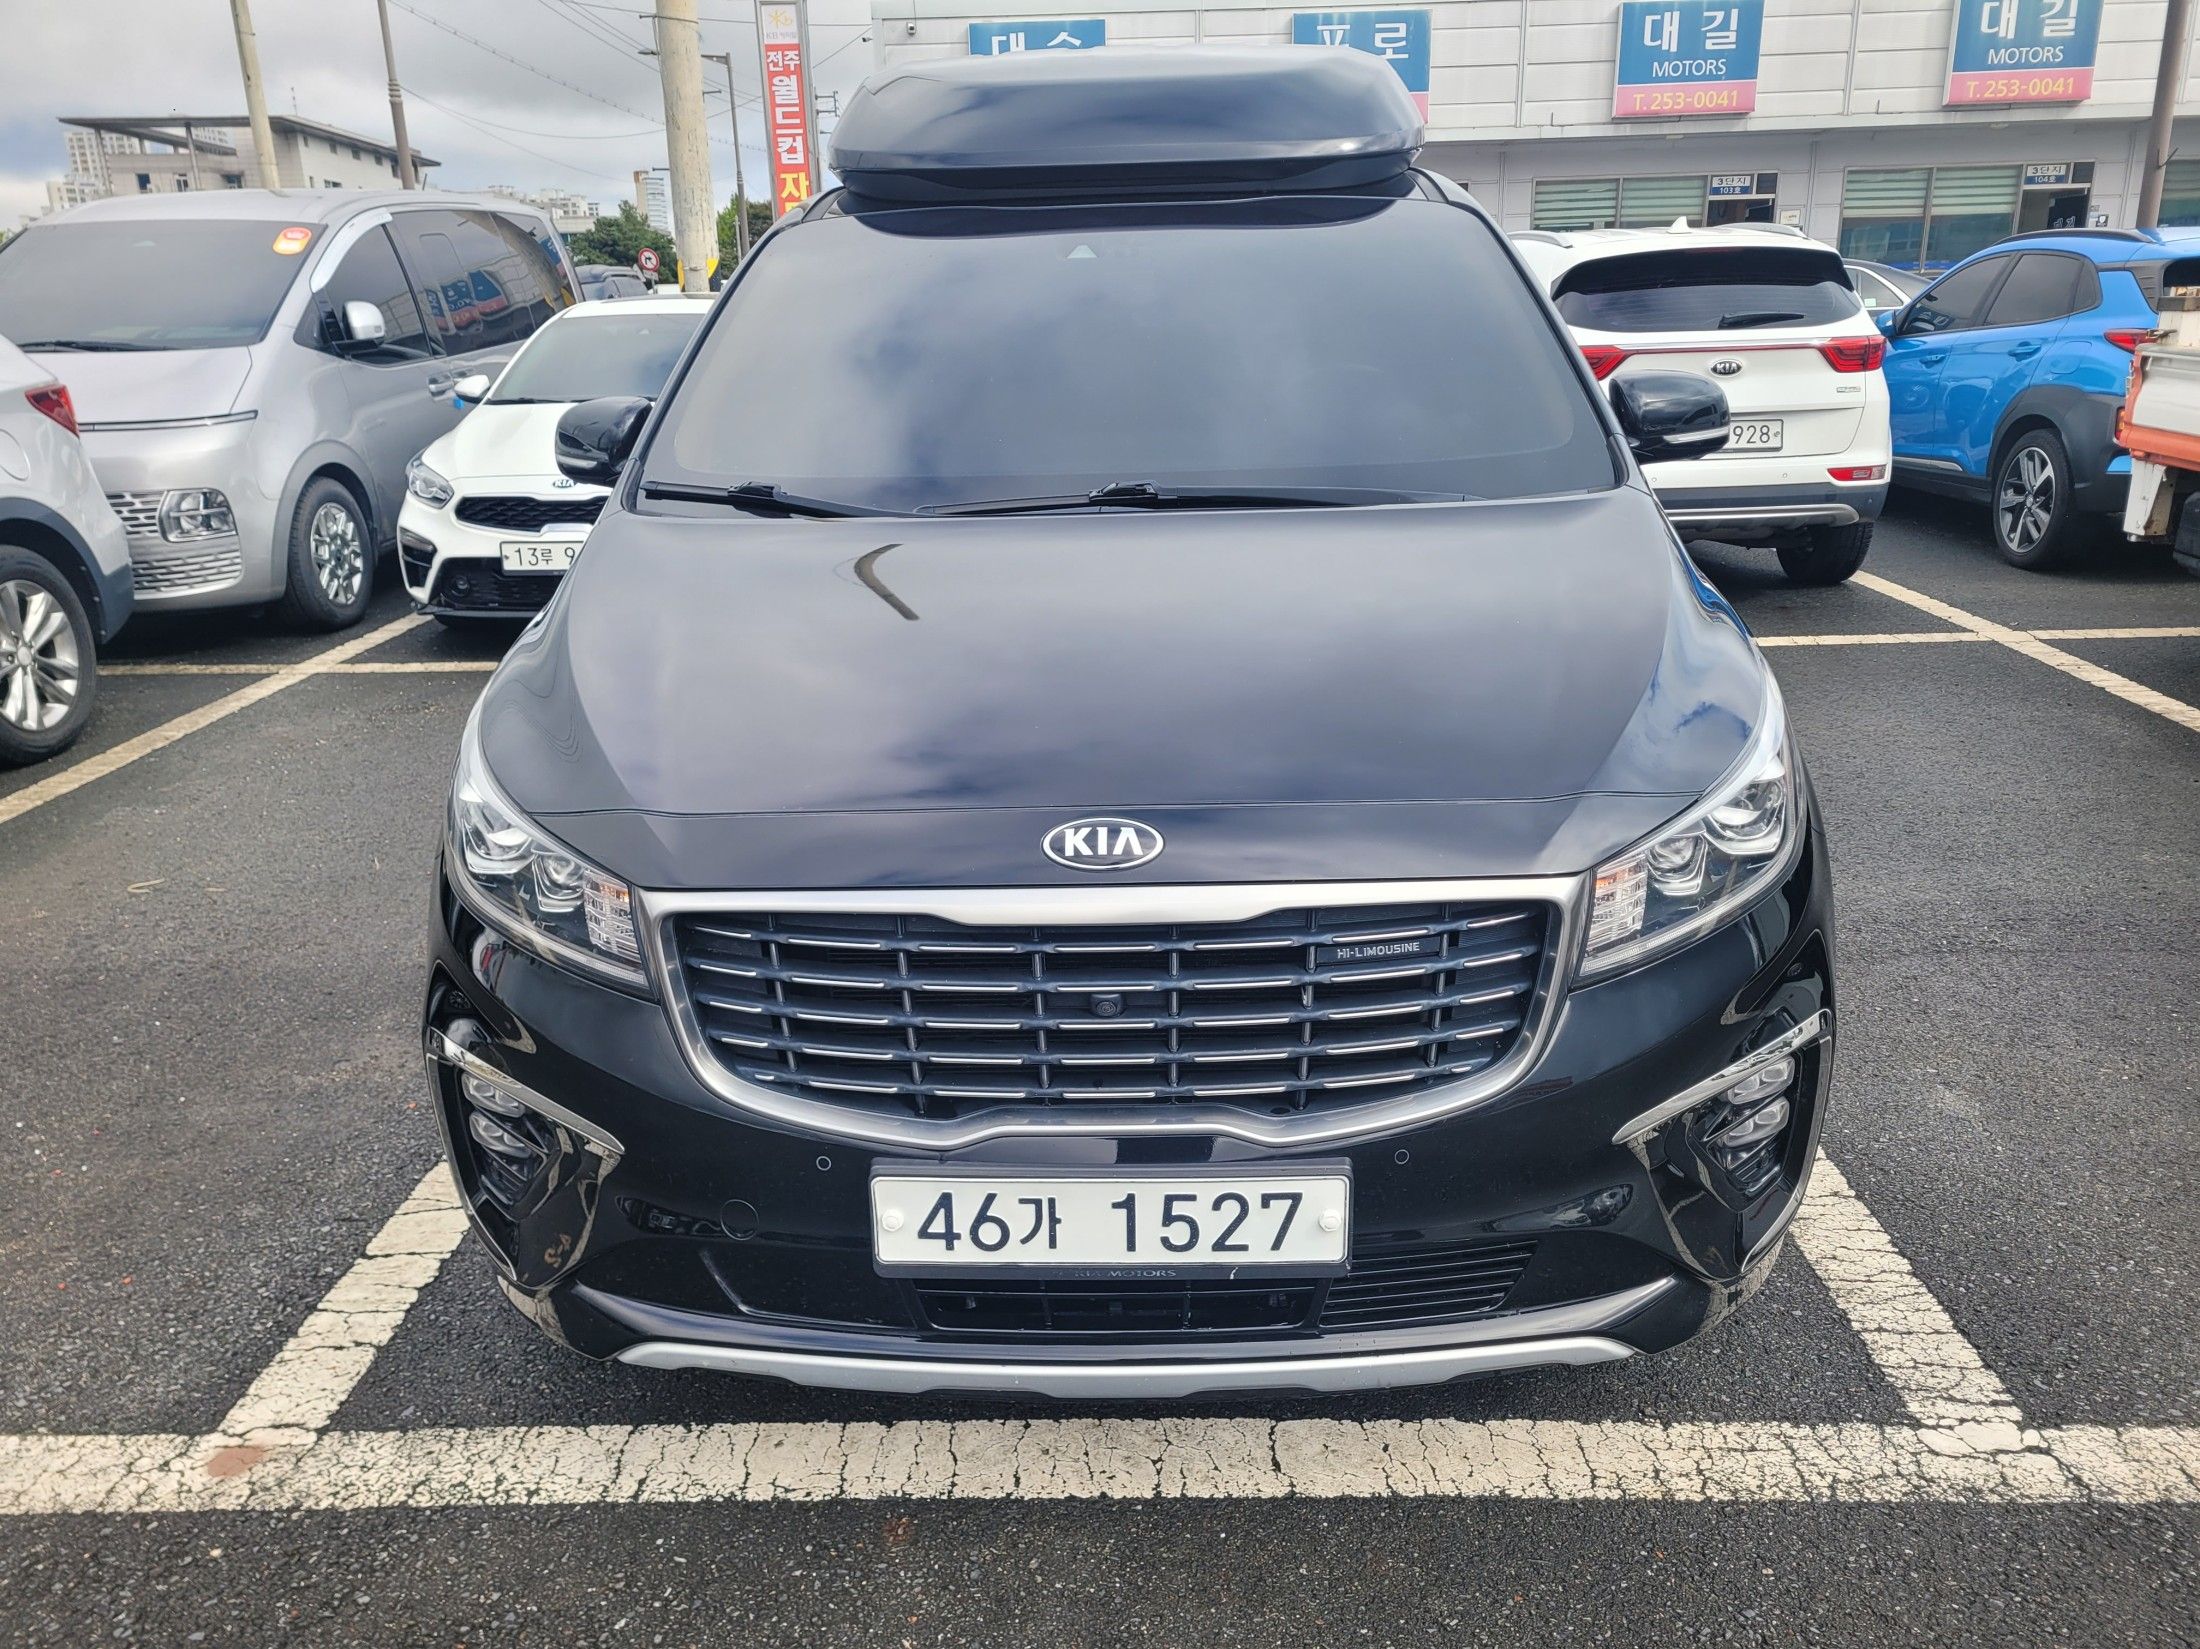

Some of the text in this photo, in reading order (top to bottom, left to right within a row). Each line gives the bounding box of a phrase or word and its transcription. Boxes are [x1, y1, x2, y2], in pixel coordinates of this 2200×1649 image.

[766, 50, 801, 72] 전주
[1987, 46, 2064, 65] MOTORS
[1652, 58, 1727, 78] MOTORS
[1967, 77, 2074, 98] T.253-0041
[1633, 90, 1739, 111] T.253-0041
[771, 74, 805, 165] 월드컵
[2032, 166, 2062, 175] 3단지
[1717, 177, 1747, 186] 3단지
[1719, 186, 1742, 195] 103호
[779, 171, 811, 214] 자
[1716, 363, 1738, 374] KIA
[514, 547, 553, 567] 13루
[1063, 826, 1144, 856] KIA
[917, 1191, 1304, 1252] 46가 1527
[1107, 1269, 1177, 1278] MOTORS
